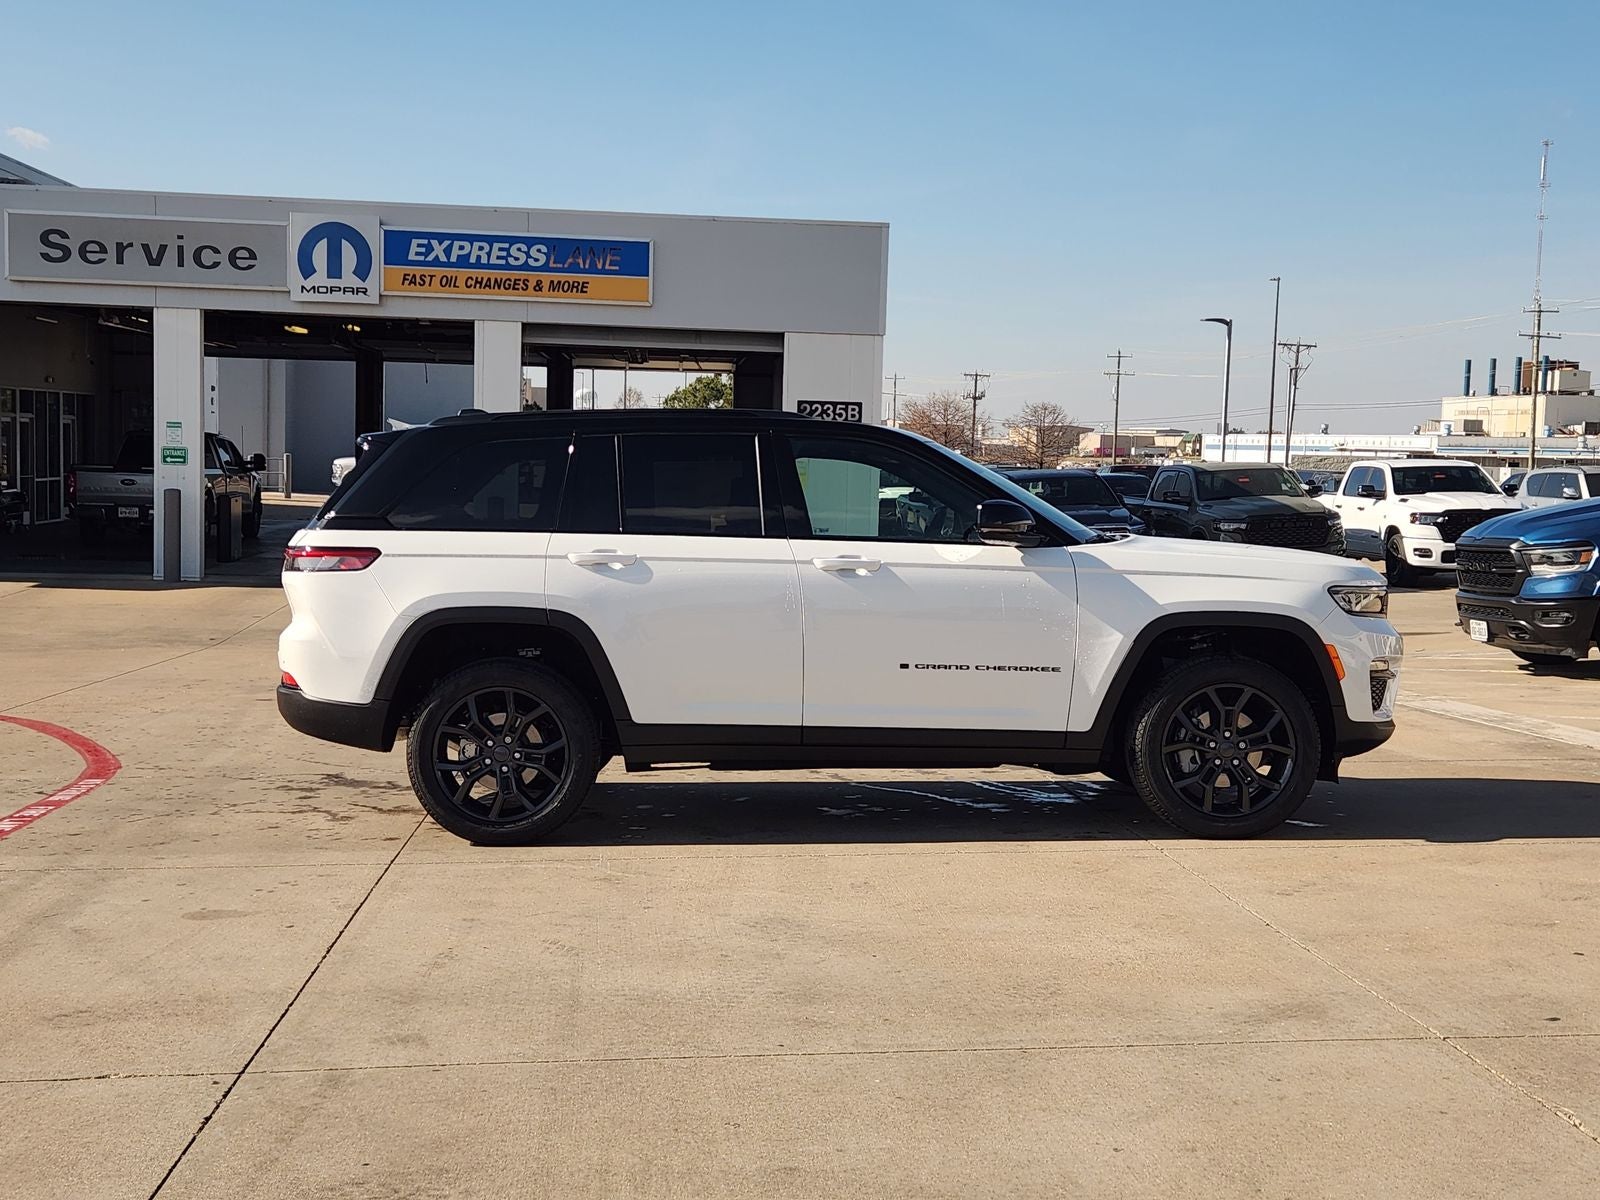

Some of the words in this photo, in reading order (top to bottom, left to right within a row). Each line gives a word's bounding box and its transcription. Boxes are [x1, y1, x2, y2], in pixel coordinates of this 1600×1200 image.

[39, 228, 258, 271] Service
[301, 285, 370, 297] MOPAR
[401, 273, 436, 288] FAST
[439, 275, 460, 289] OIL
[464, 276, 529, 292] CHANGES
[533, 280, 544, 293] &
[548, 280, 590, 294] MORE
[800, 403, 860, 421] 2235B
[163, 449, 186, 457] ENTRANCE
[914, 663, 970, 671] GRAND
[975, 664, 1062, 673] CHEROKEE
